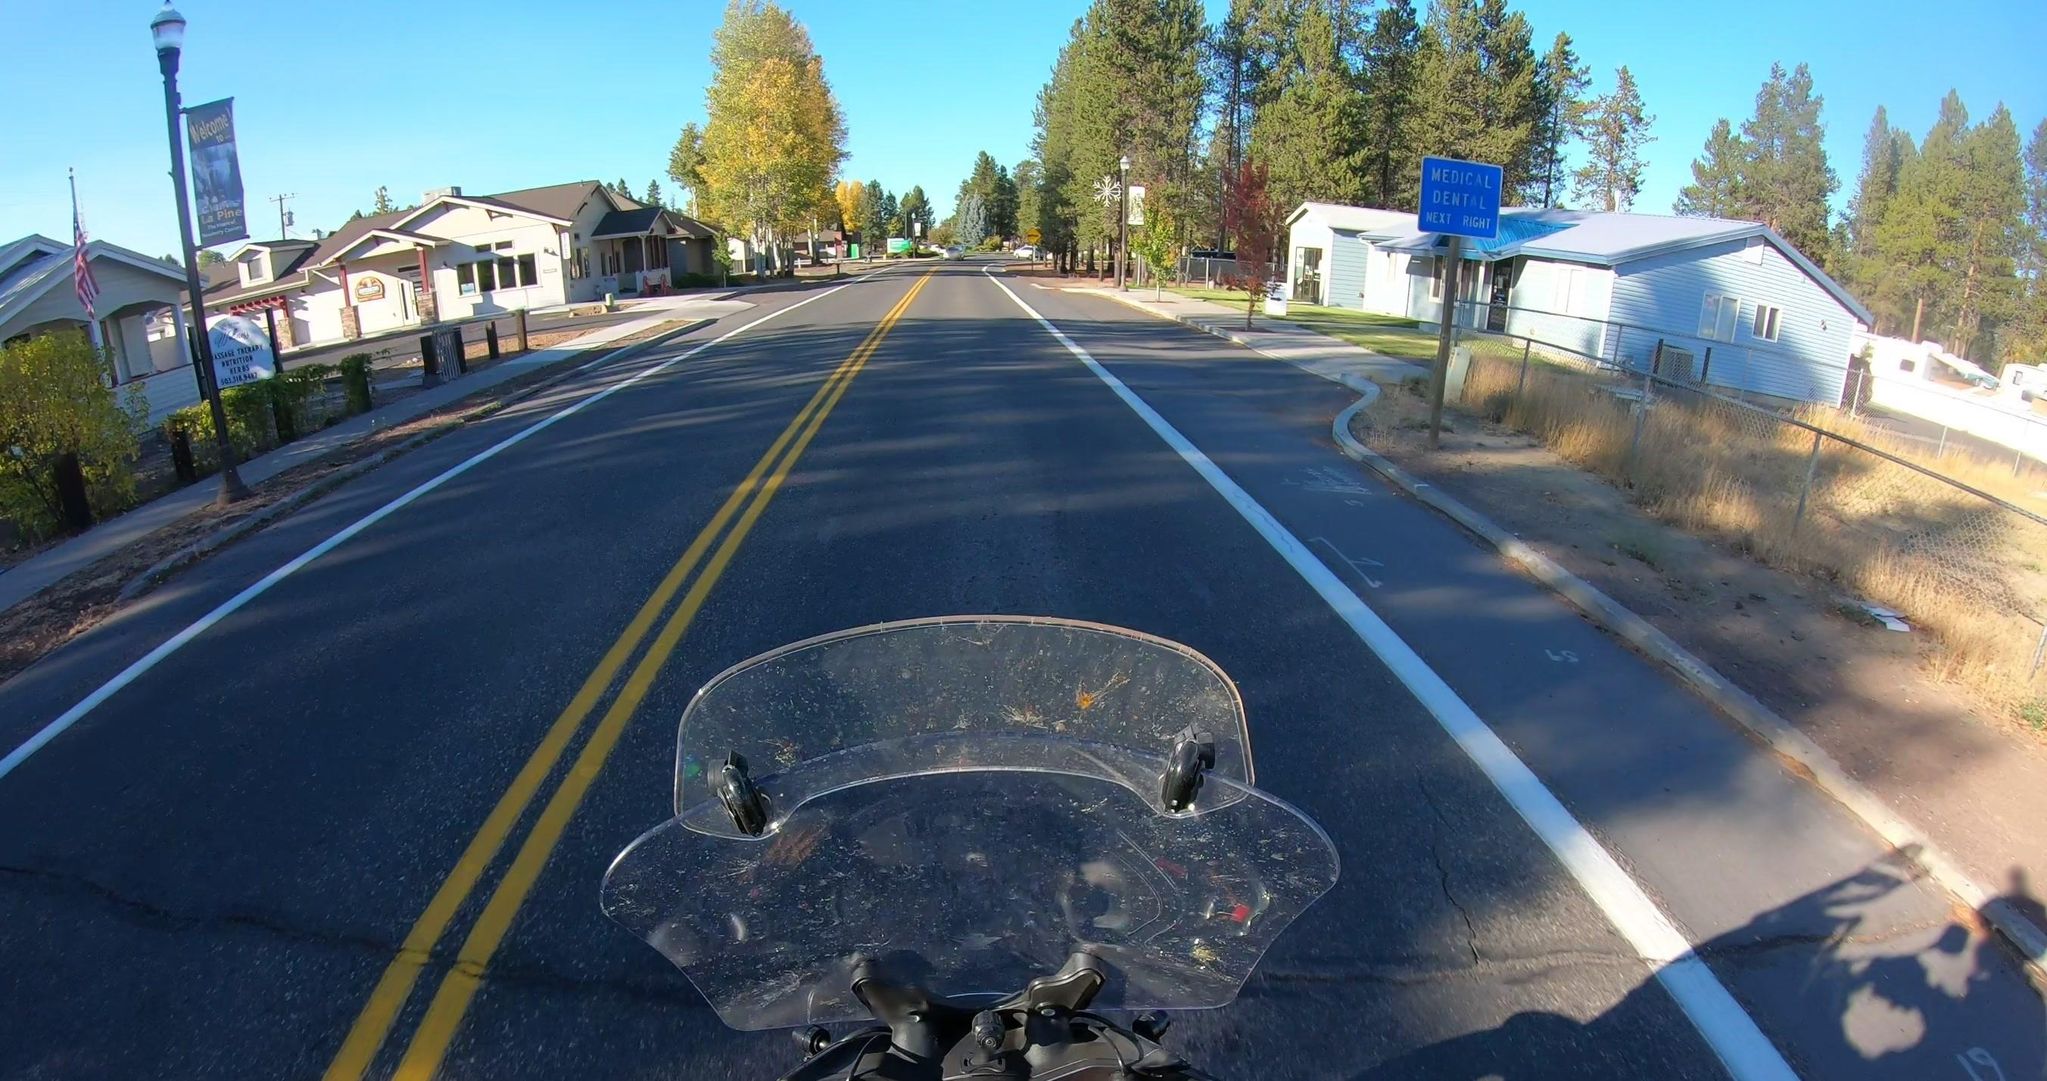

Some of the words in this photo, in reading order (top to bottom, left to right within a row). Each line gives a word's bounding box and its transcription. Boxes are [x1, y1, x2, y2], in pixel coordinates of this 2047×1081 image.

[1431, 167, 1492, 189] MEDICAL
[1433, 190, 1487, 210] DENTAL
[217, 207, 242, 220] Pine
[1426, 211, 1451, 225] NEXT
[1463, 215, 1491, 229] RIGHT
[214, 350, 235, 360] ASSAGE
[221, 355, 253, 367] NUTRITION
[230, 364, 250, 375] HERBS
